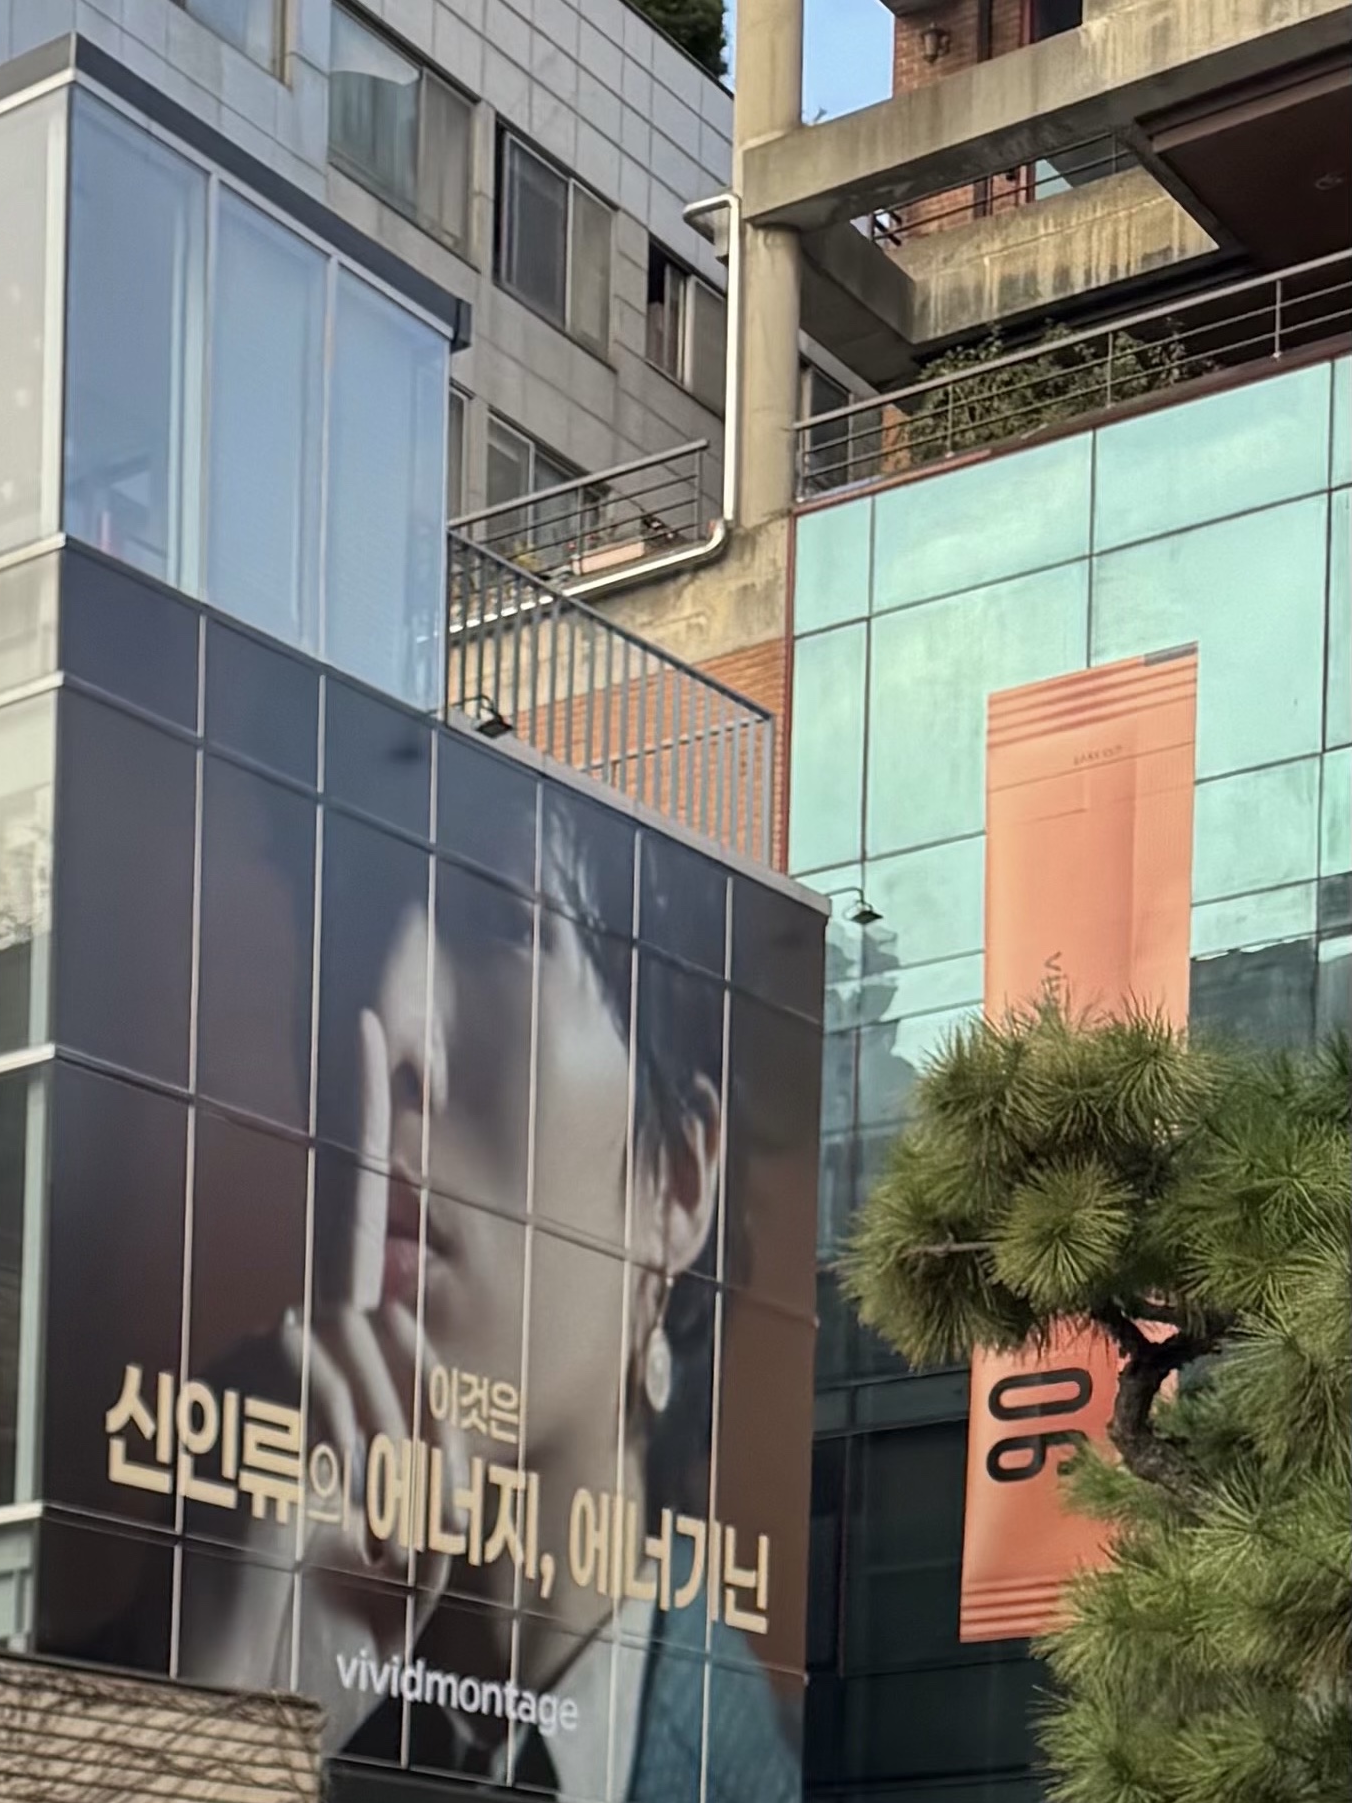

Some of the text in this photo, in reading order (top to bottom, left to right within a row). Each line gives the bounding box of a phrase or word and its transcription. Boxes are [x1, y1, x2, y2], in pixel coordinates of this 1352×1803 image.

[428, 1364, 520, 1444] 이것은
[105, 1364, 351, 1532] 신인류의
[366, 1432, 556, 1599] 에너지,
[336, 1648, 579, 1736] vividmontage
